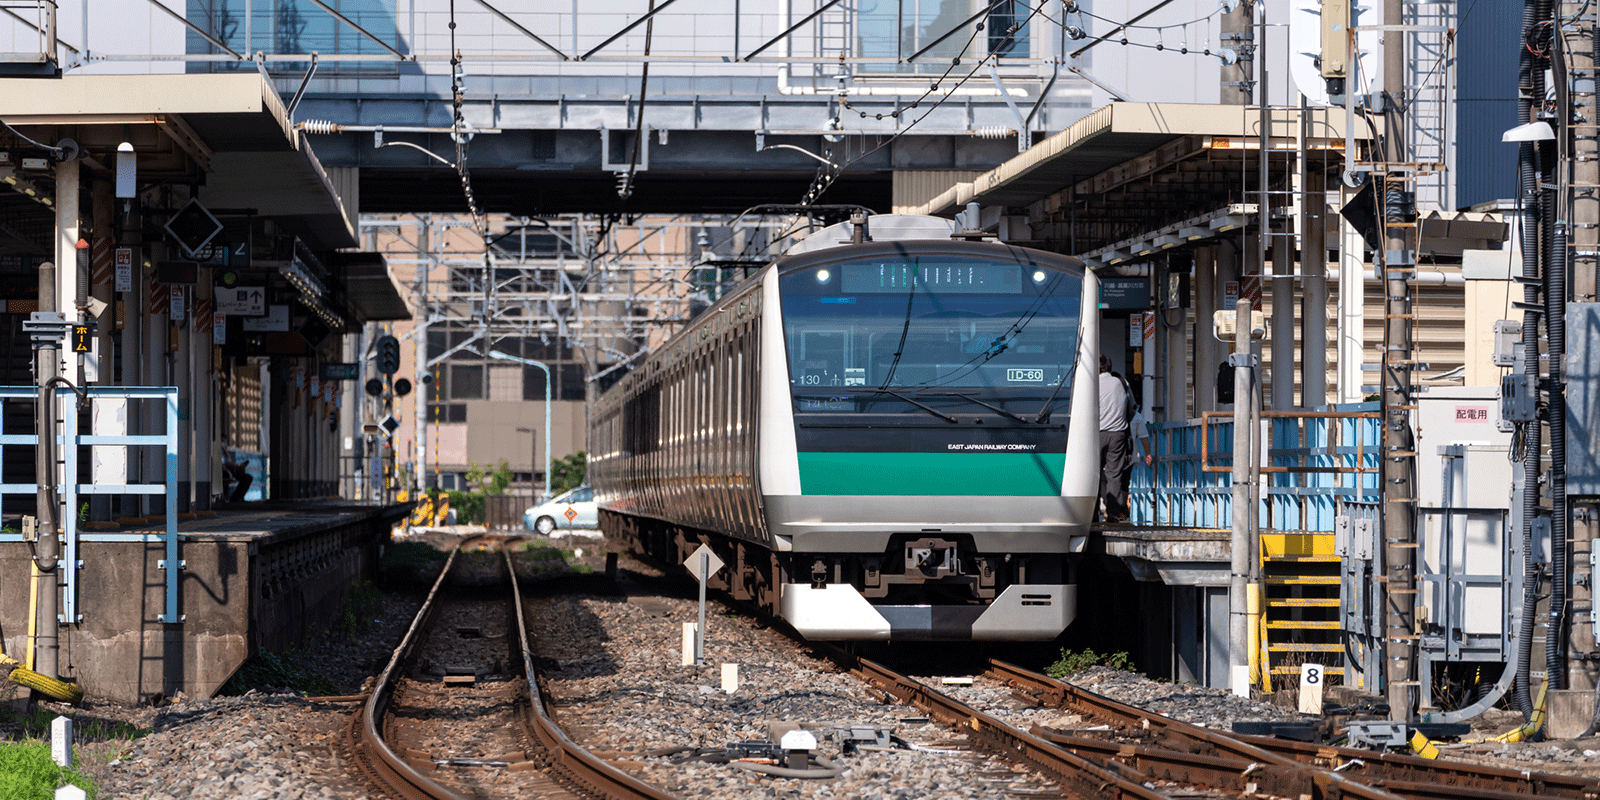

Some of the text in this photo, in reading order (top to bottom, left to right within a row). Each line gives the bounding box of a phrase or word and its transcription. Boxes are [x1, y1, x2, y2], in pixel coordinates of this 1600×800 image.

[76, 326, 88, 352] ホーム
[800, 374, 820, 385] 130
[1455, 409, 1488, 420] 配電用
[1306, 667, 1320, 685] 8
